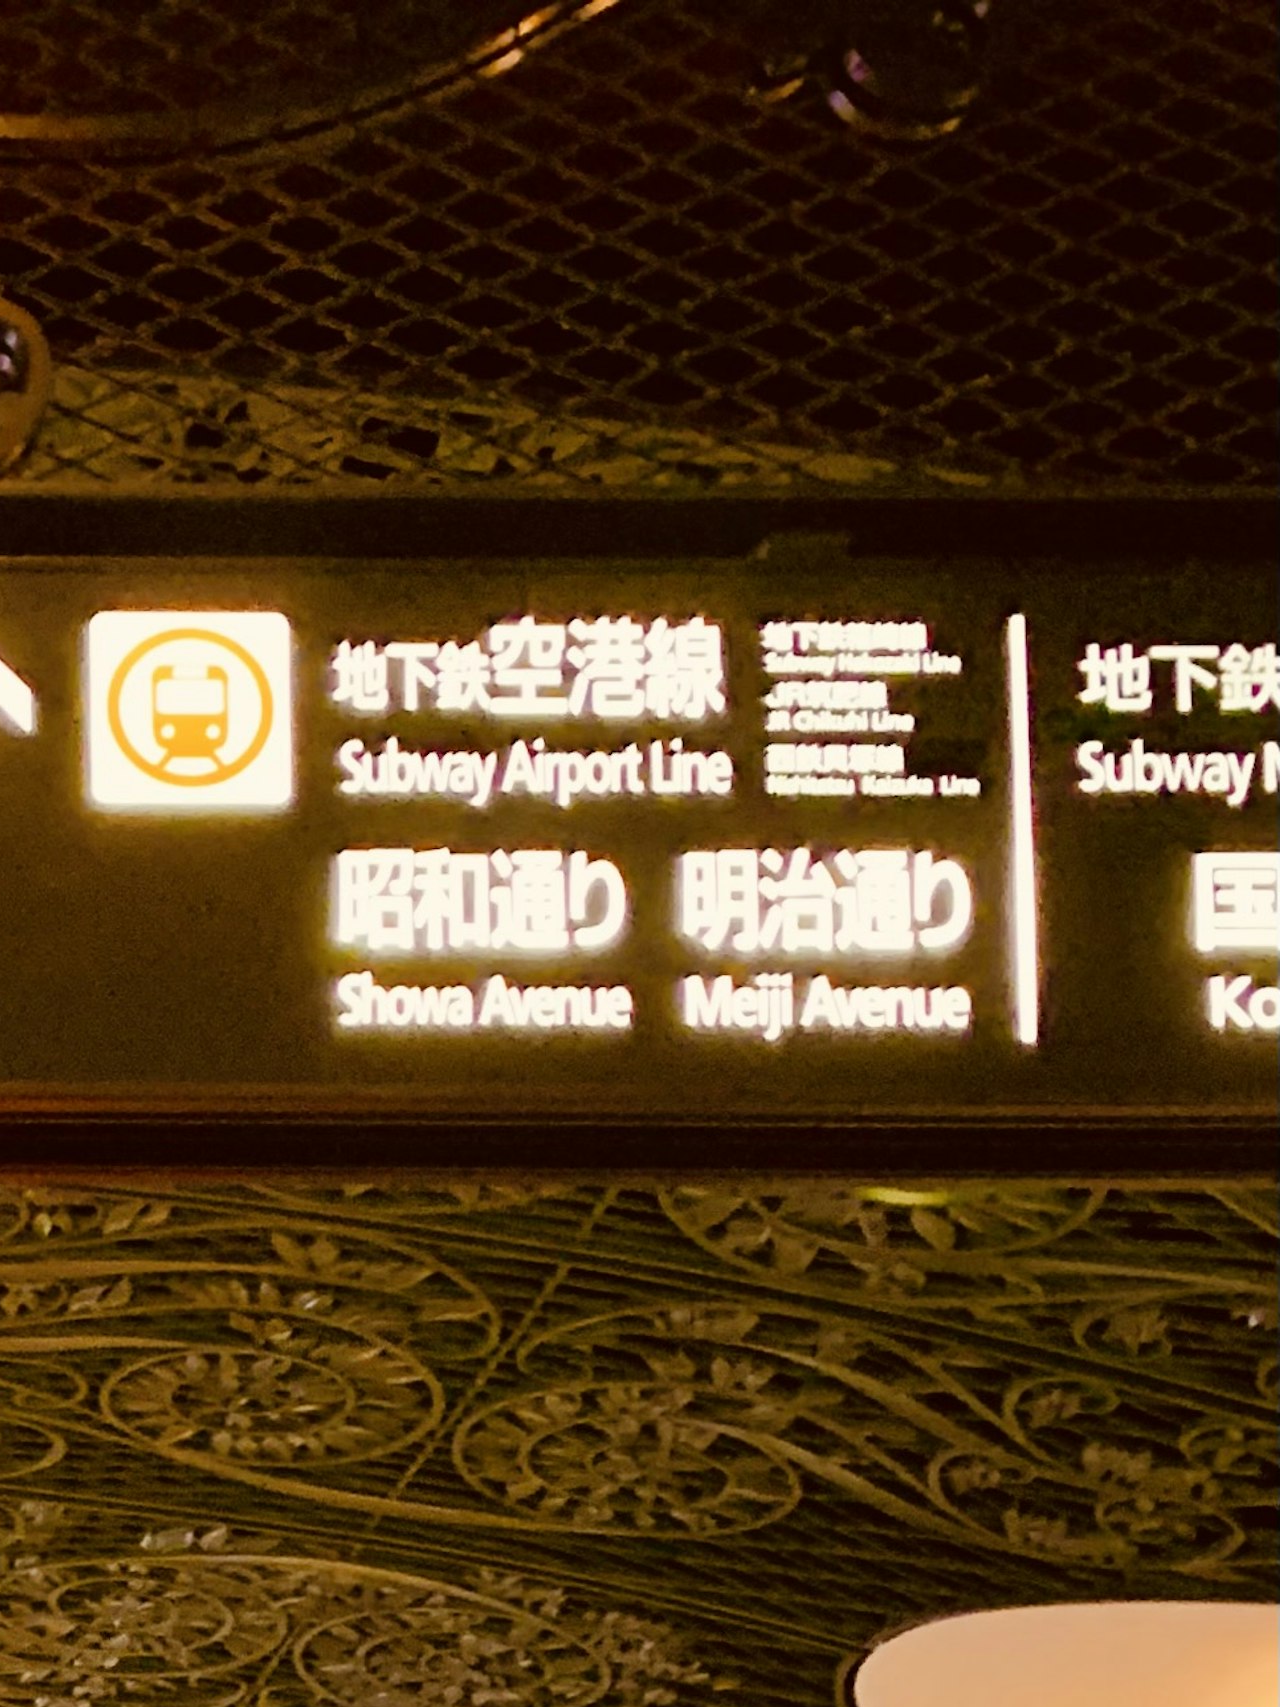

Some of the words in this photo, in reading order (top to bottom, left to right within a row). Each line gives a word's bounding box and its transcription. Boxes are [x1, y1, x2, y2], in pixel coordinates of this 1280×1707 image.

[332, 617, 725, 718] 地下鉄空港線
[339, 738, 497, 806] Subway
[500, 738, 645, 806] Airport
[651, 739, 733, 793] Line
[1078, 739, 1255, 806] Subway
[336, 848, 627, 952] 昭和通り
[681, 848, 971, 952] 明治通り
[338, 972, 474, 1027] Showa
[478, 975, 633, 1028] Avenue
[684, 974, 794, 1041] Meiji
[799, 975, 971, 1029] Avenue
